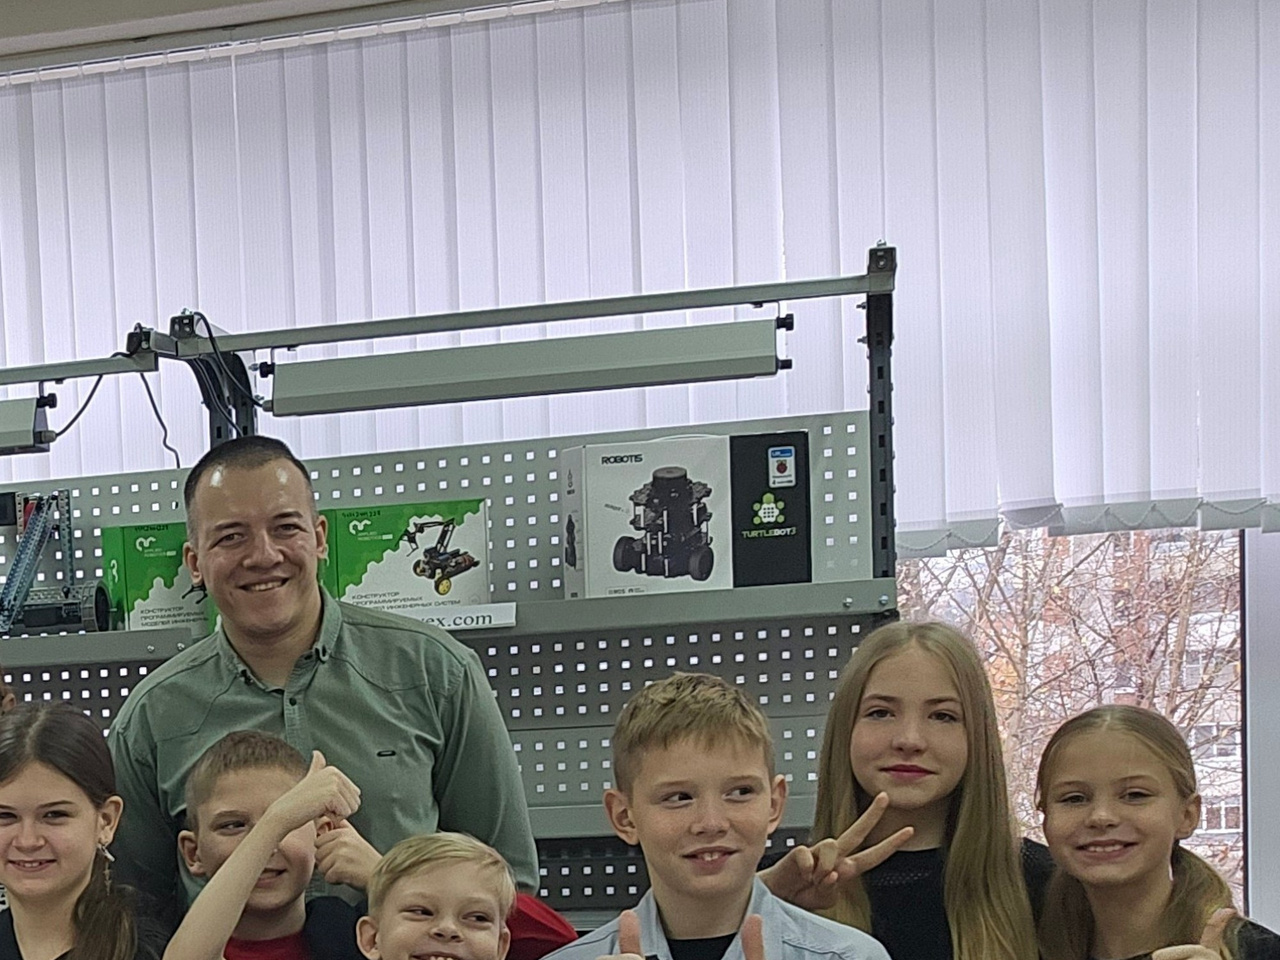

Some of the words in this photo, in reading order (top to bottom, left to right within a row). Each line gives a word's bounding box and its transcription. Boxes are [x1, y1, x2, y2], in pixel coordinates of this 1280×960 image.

[601, 454, 643, 465] ROBOTIS
[742, 527, 797, 538] TURTLEBOT3
[352, 592, 400, 600] КОНСТРУКТОР
[140, 606, 184, 614] КОНСТРУКТОР
